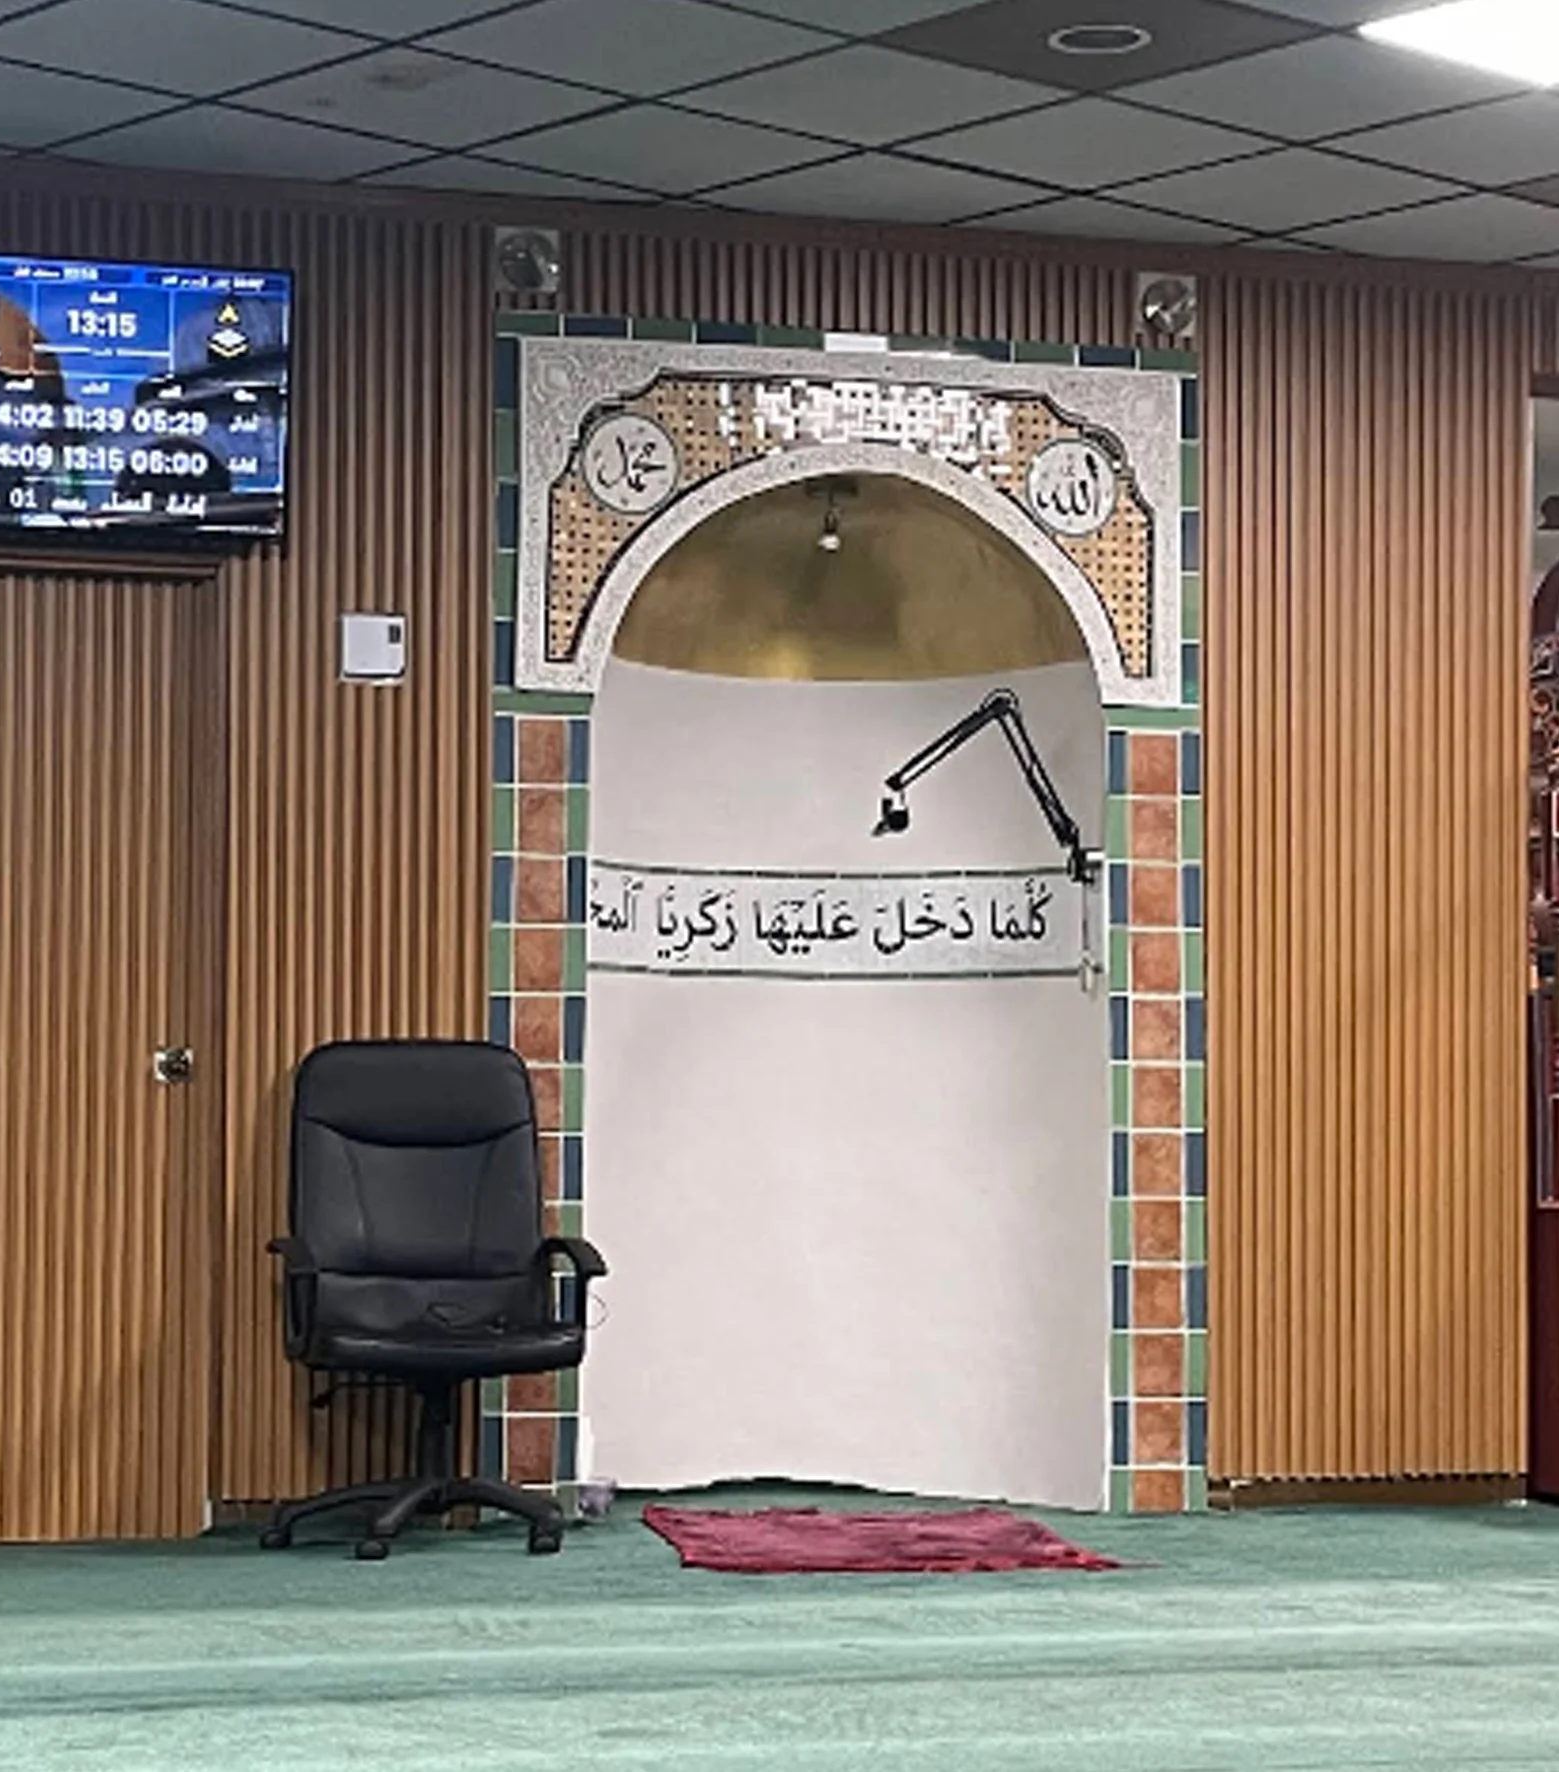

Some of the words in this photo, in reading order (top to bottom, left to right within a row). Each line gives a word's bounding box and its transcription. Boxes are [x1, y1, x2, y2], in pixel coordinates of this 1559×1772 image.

[67, 309, 137, 338] 13:15
[63, 404, 125, 432] 11:39
[132, 408, 208, 435] 05:29
[10, 487, 37, 508] 01
